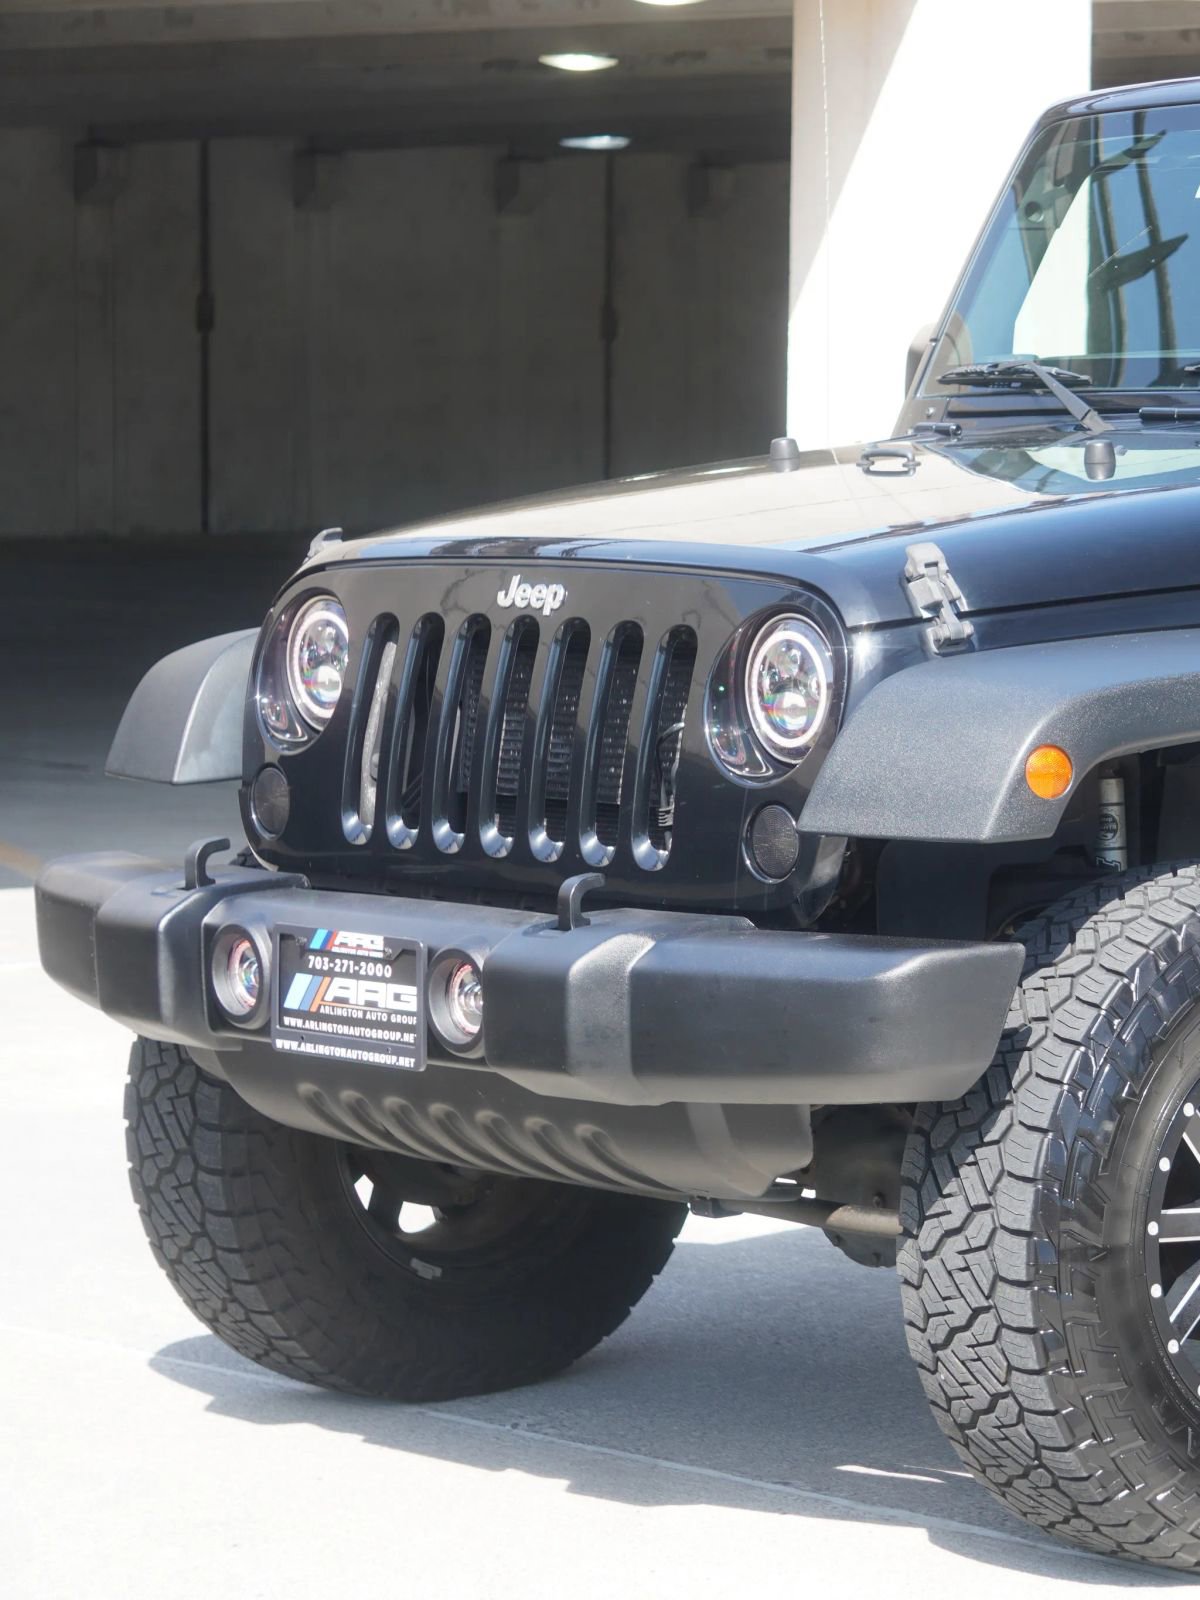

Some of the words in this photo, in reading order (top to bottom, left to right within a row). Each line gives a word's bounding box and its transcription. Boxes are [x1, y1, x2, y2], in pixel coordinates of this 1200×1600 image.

[496, 574, 566, 616] Jeep
[308, 955, 392, 978] 703-271-2000
[323, 977, 417, 1012] AAG
[319, 1005, 365, 1020] ARLINGTON
[365, 1011, 388, 1022] AUTO
[283, 1016, 417, 1043] WWW.ARLINGTONAUTOGROUP.NE
[275, 1039, 416, 1068] WWW.ARLINGTONAUTOGROUP.NET
